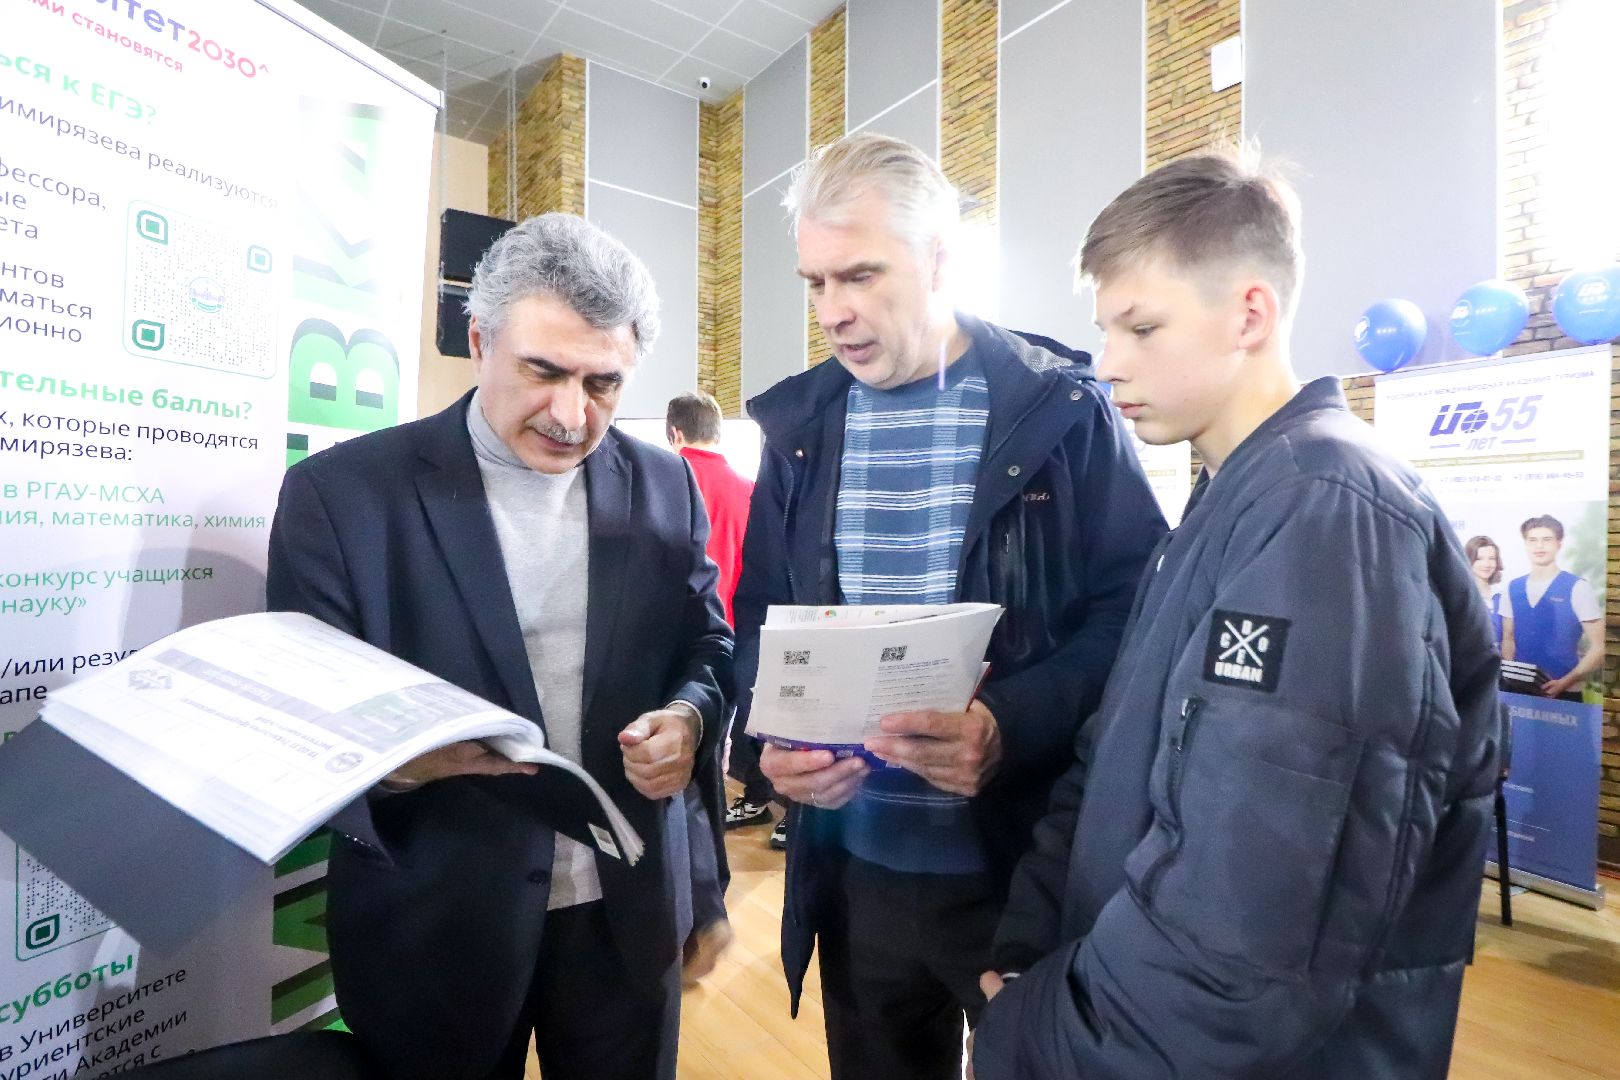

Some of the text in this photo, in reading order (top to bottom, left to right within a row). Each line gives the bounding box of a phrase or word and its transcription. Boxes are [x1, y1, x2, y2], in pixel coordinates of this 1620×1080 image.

[72, 12, 183, 73] становятся
[91, 82, 157, 125] ЕГЭ?
[152, 388, 253, 420] баллы?
[22, 413, 131, 438] которые
[136, 425, 258, 450] проводятся
[3, 481, 165, 504] в РГАУ-МСХА
[52, 510, 198, 529] математика,
[204, 514, 265, 529] химия
[103, 566, 213, 588] учащихся
[0, 953, 134, 1025] субботы
[20, 968, 187, 1054] Университете
[74, 1010, 188, 1076] Академии
